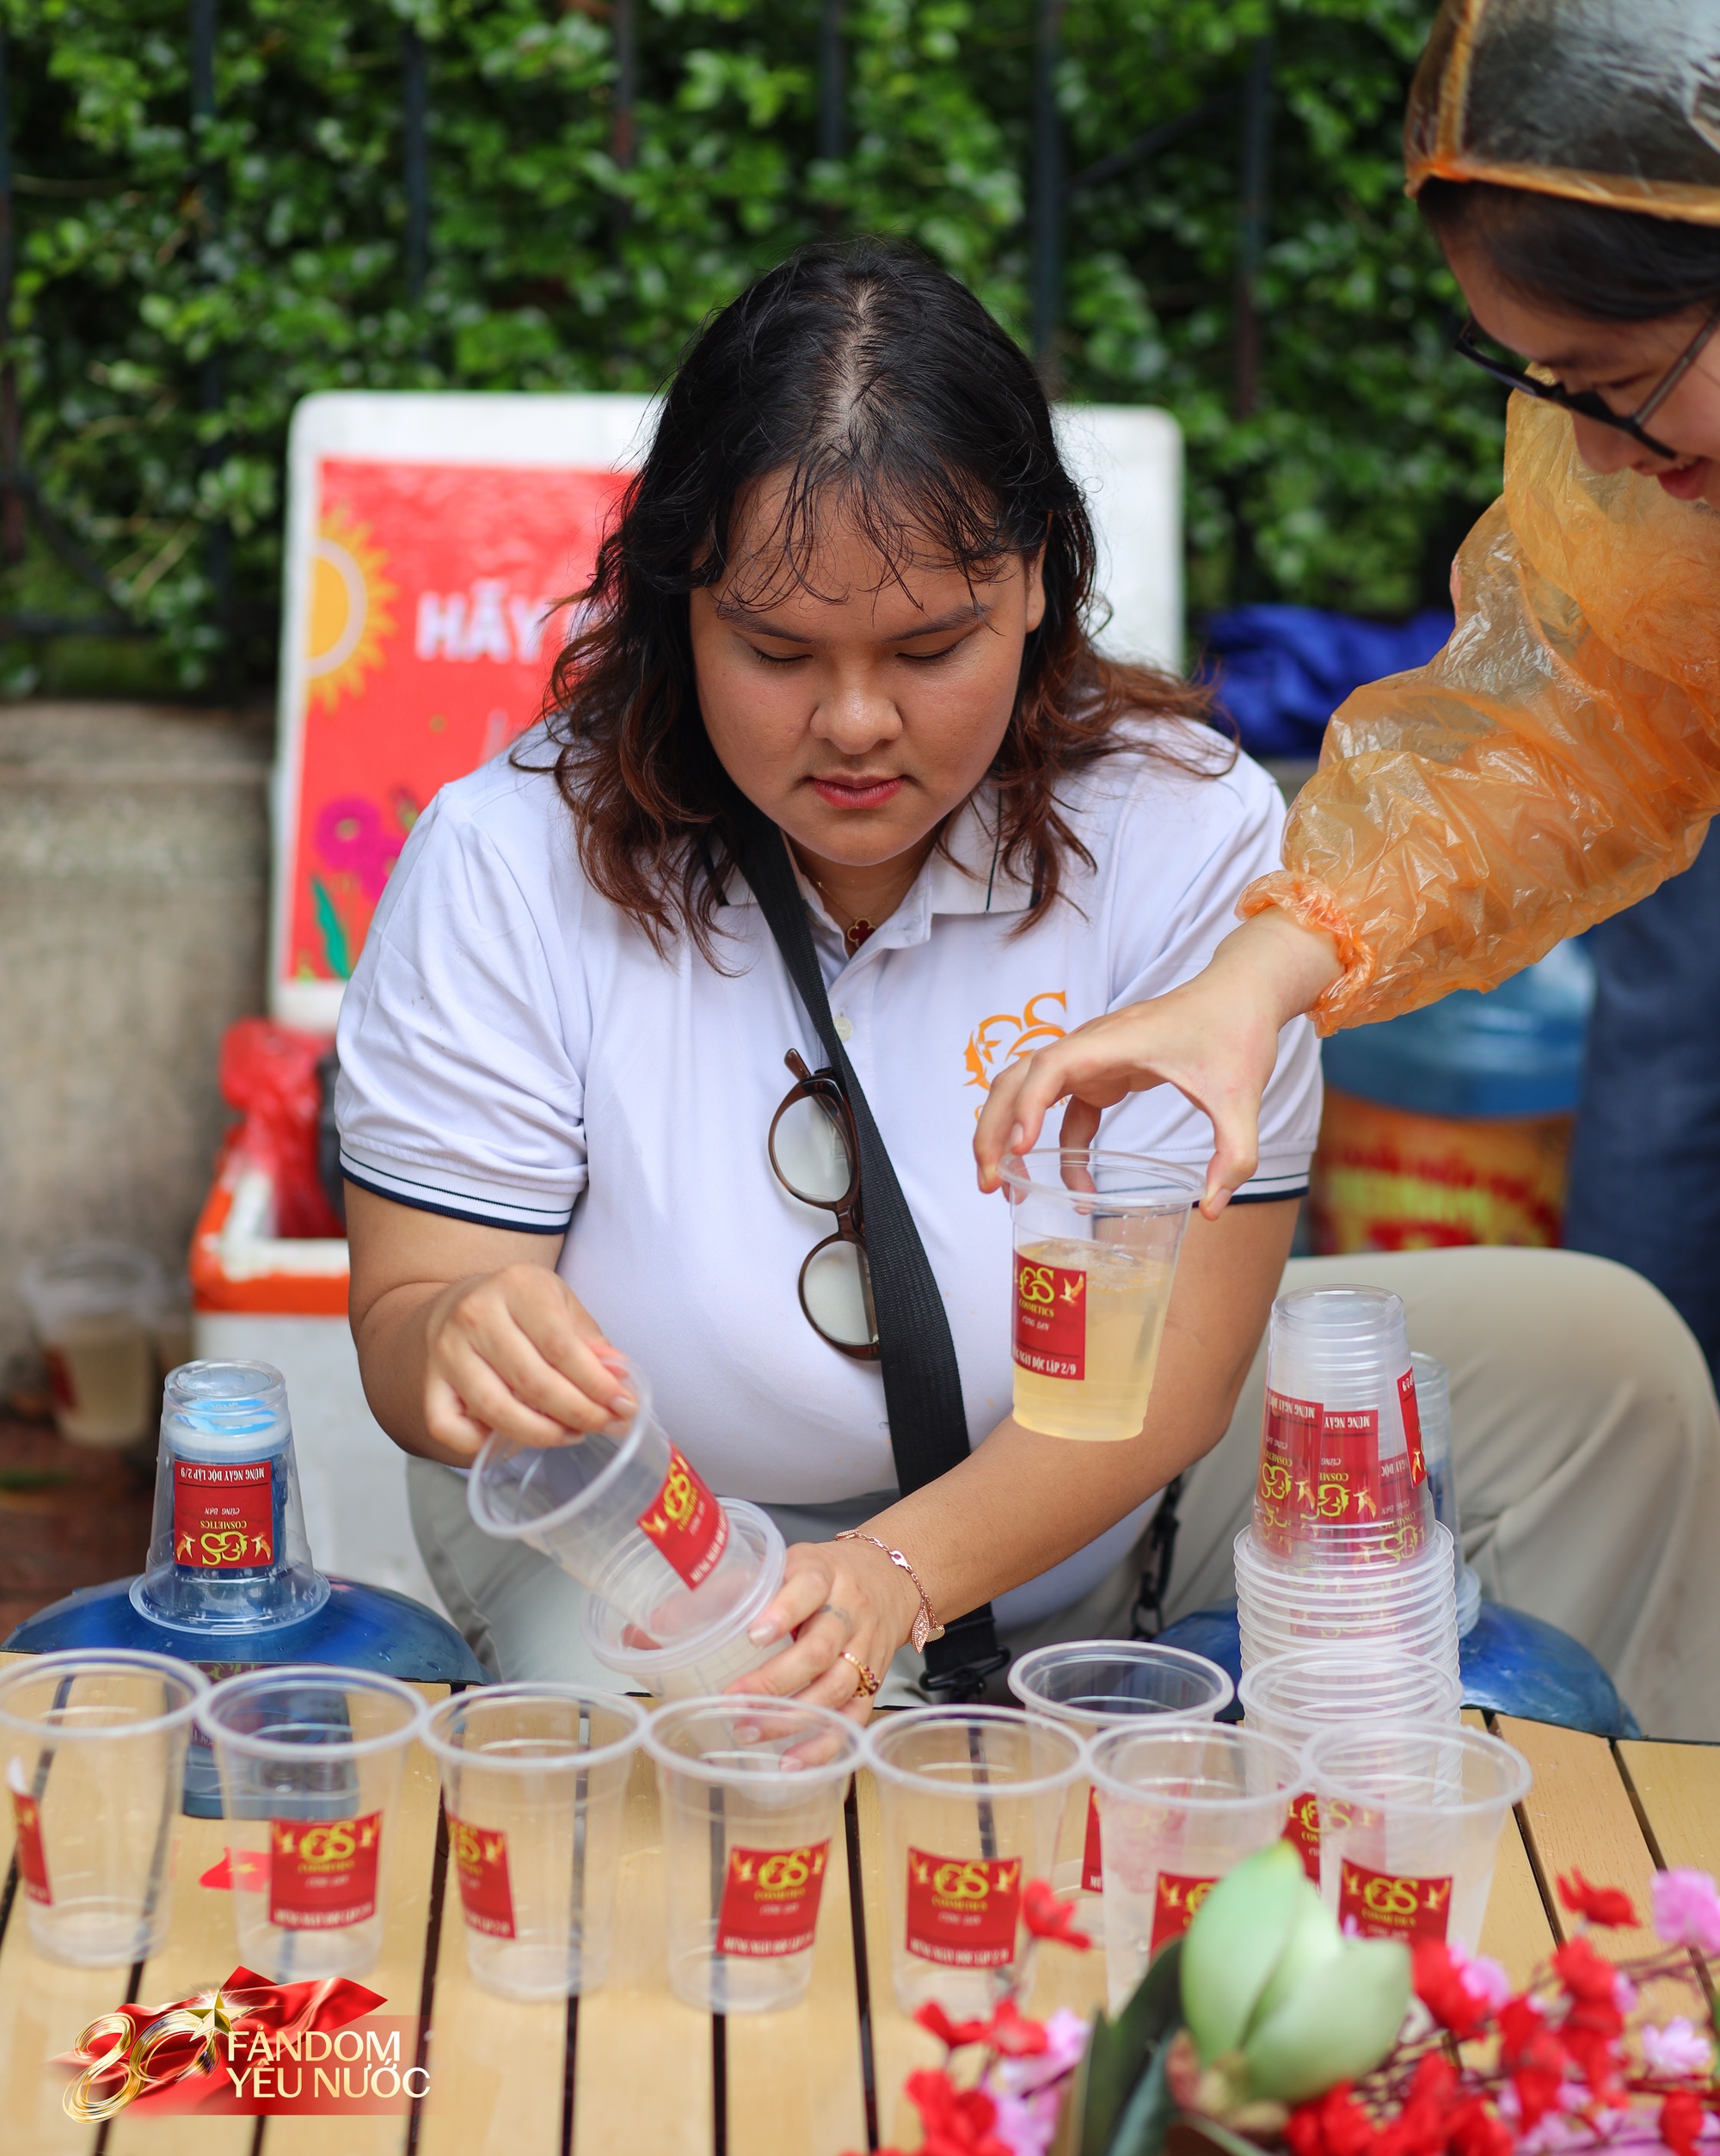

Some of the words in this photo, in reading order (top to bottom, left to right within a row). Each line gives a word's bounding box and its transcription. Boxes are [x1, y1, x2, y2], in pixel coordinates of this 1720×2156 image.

[1018, 1298, 1055, 1318] COSMETICS
[1060, 1362, 1077, 1376] 2/9
[181, 1466, 193, 1479] 2/9
[200, 1520, 248, 1529] COSMETICS
[200, 1531, 249, 1565] GS
